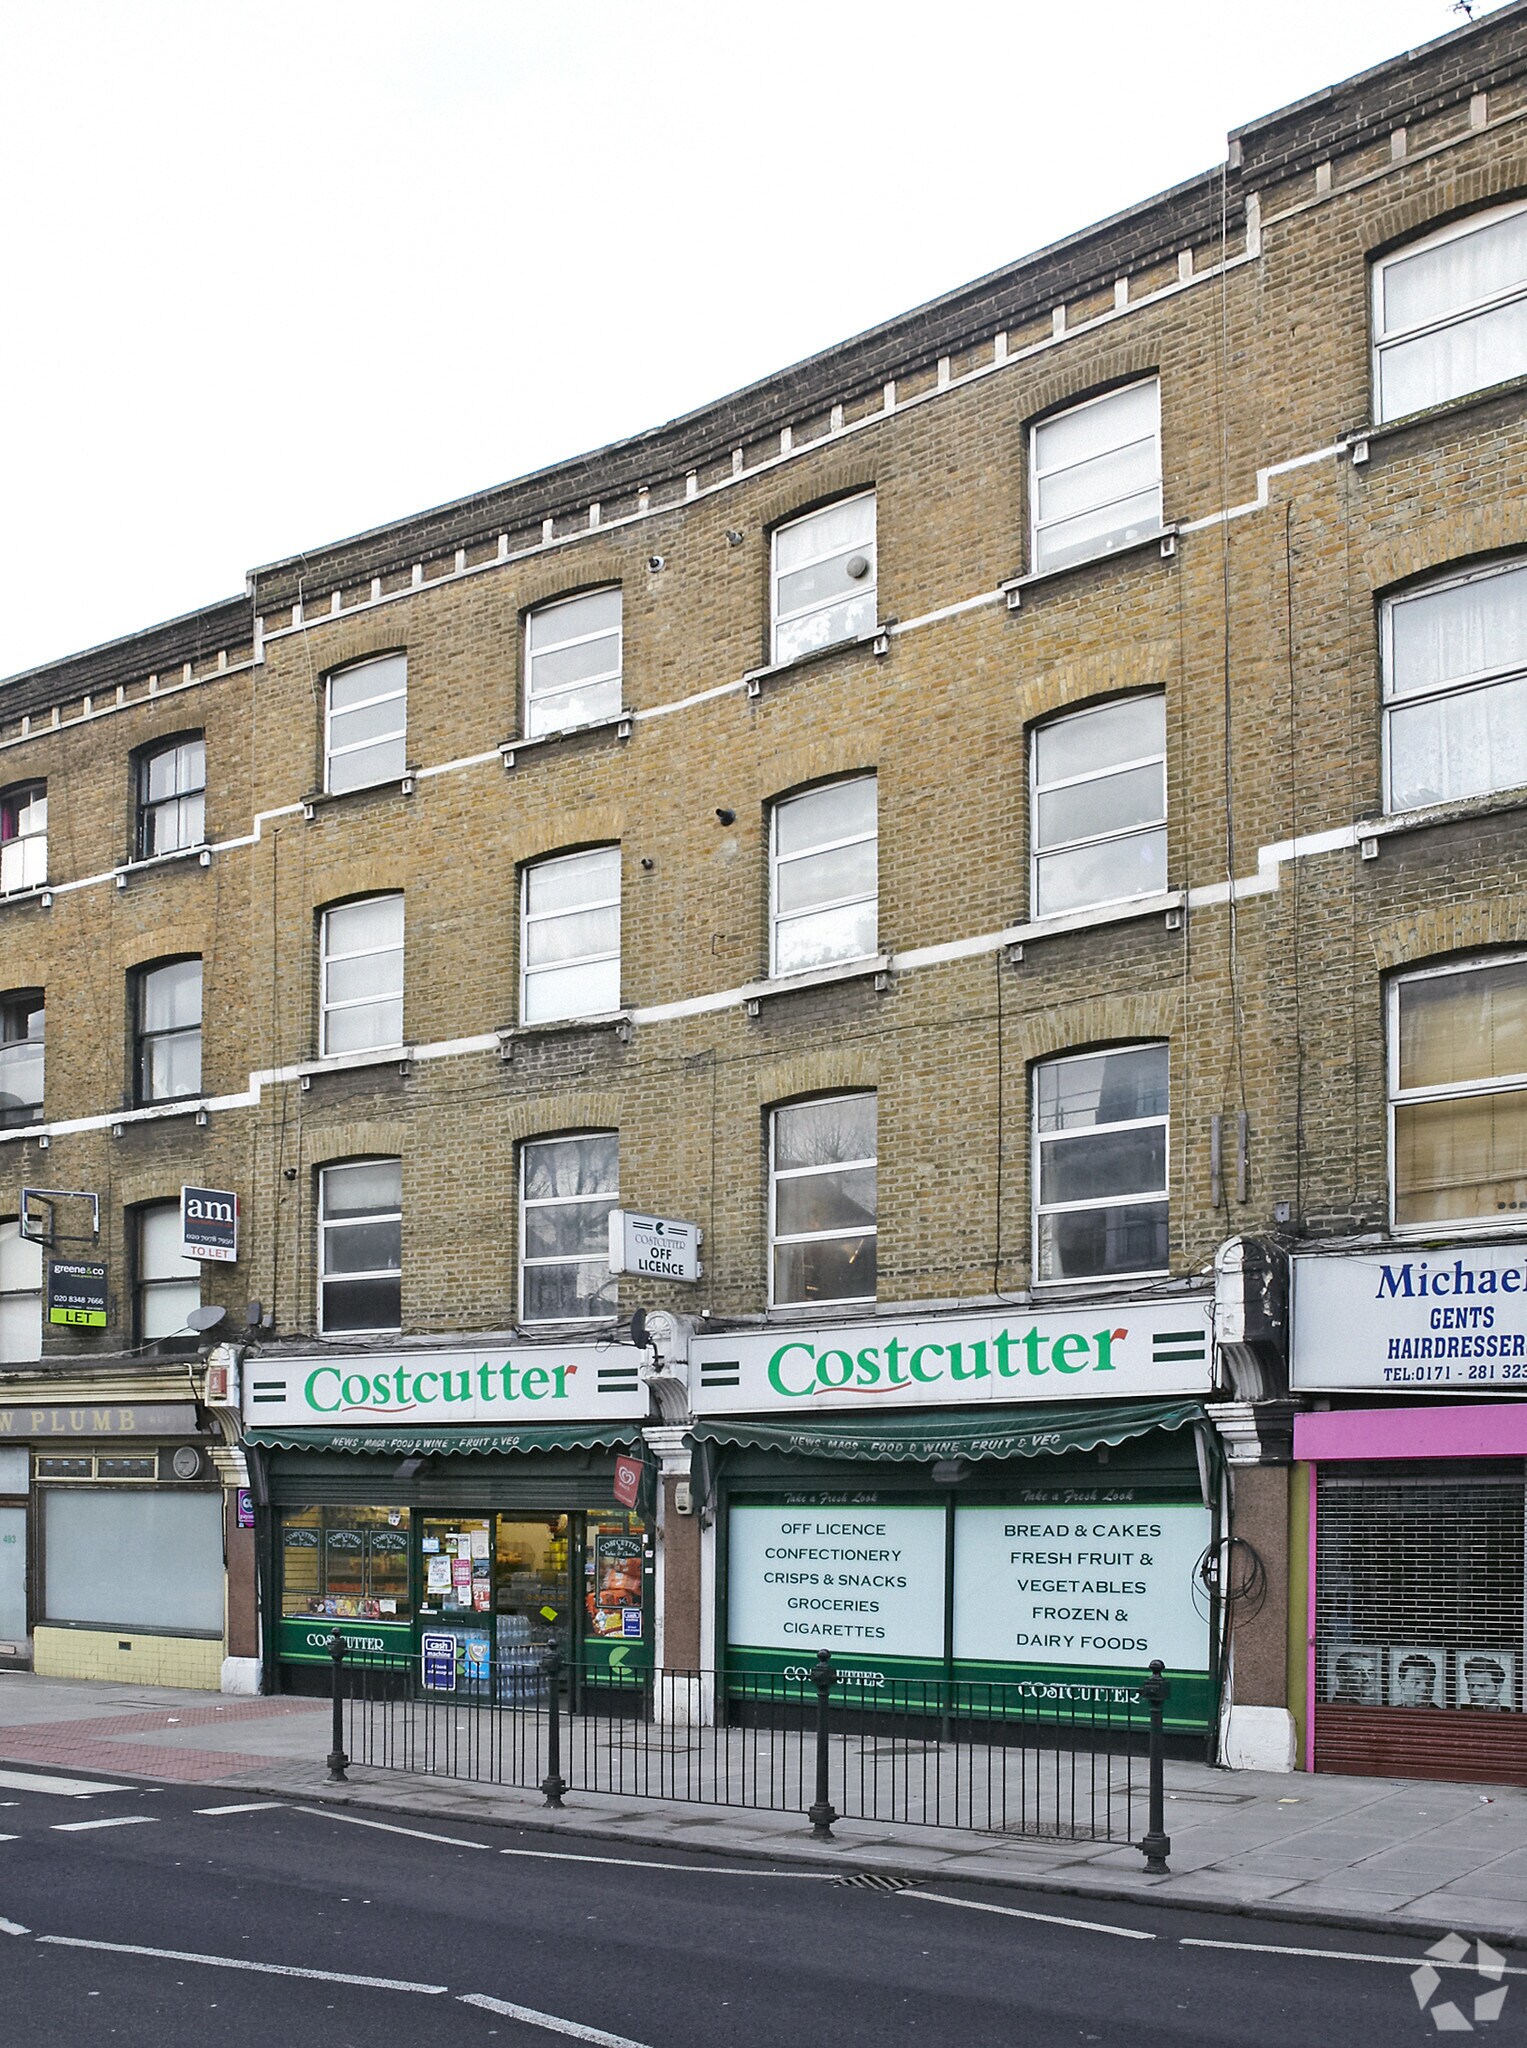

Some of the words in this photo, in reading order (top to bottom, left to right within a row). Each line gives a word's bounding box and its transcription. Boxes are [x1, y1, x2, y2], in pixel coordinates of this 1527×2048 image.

[187, 1199, 234, 1222] am
[635, 1234, 686, 1250] COSTCUTTER
[191, 1246, 206, 1256] TO
[208, 1248, 229, 1258] LET
[650, 1247, 672, 1260] OFF
[638, 1259, 685, 1275] LICENCE
[1375, 1256, 1527, 1299] Michael
[53, 1295, 68, 1303] 020
[68, 1296, 86, 1304] 8348
[86, 1297, 104, 1305] 7666
[65, 1311, 92, 1323] LET
[1430, 1306, 1495, 1330] GENTS
[1387, 1335, 1527, 1359] HAIRDRESSER
[767, 1326, 1129, 1397] Costcutter
[1468, 1365, 1494, 1379] 281
[304, 1360, 578, 1412] Costcutter
[31, 1409, 136, 1432] PLUMB
[332, 1437, 359, 1447] NEWS
[390, 1438, 413, 1448] FOOD
[423, 1439, 449, 1448] WINE
[459, 1438, 490, 1447] FRUIT
[501, 1436, 520, 1446] VEG
[789, 1435, 821, 1446] NEWS
[870, 1442, 903, 1452] FOOD
[923, 1441, 959, 1452] WINE
[970, 1438, 1015, 1451] FRUIT
[1031, 1434, 1061, 1446] VEG
[784, 1491, 806, 1504] Take
[851, 1491, 878, 1503] Look
[1021, 1489, 1048, 1502] Take
[1051, 1493, 1059, 1501] a
[1063, 1488, 1098, 1503] Fresh
[1101, 1488, 1135, 1501] Look
[780, 1522, 812, 1535] OFF
[816, 1522, 886, 1536] LICENCE
[1004, 1524, 1070, 1537] BREAD
[1073, 1524, 1088, 1537] &
[1092, 1524, 1162, 1538] CAKES
[764, 1547, 902, 1562] CONFECTIONERY
[1010, 1552, 1073, 1565] FRESH
[1077, 1552, 1134, 1566] FRUIT
[1139, 1553, 1154, 1567] &
[763, 1571, 820, 1585] CRISPS
[823, 1573, 835, 1586] &
[838, 1574, 908, 1588] SNACKS
[1017, 1579, 1147, 1594] VEGETABLES
[473, 1591, 485, 1600] 21
[787, 1598, 880, 1612] GROCERIES
[1032, 1607, 1110, 1621] FROZEN
[1114, 1608, 1129, 1622] &
[783, 1622, 886, 1639] CIGARETTES
[306, 1633, 384, 1651] COSUTTER
[431, 1641, 448, 1650] cash
[1016, 1633, 1075, 1648] DAIRY
[1080, 1636, 1148, 1651] FOODS
[784, 1665, 885, 1688] COUTTER
